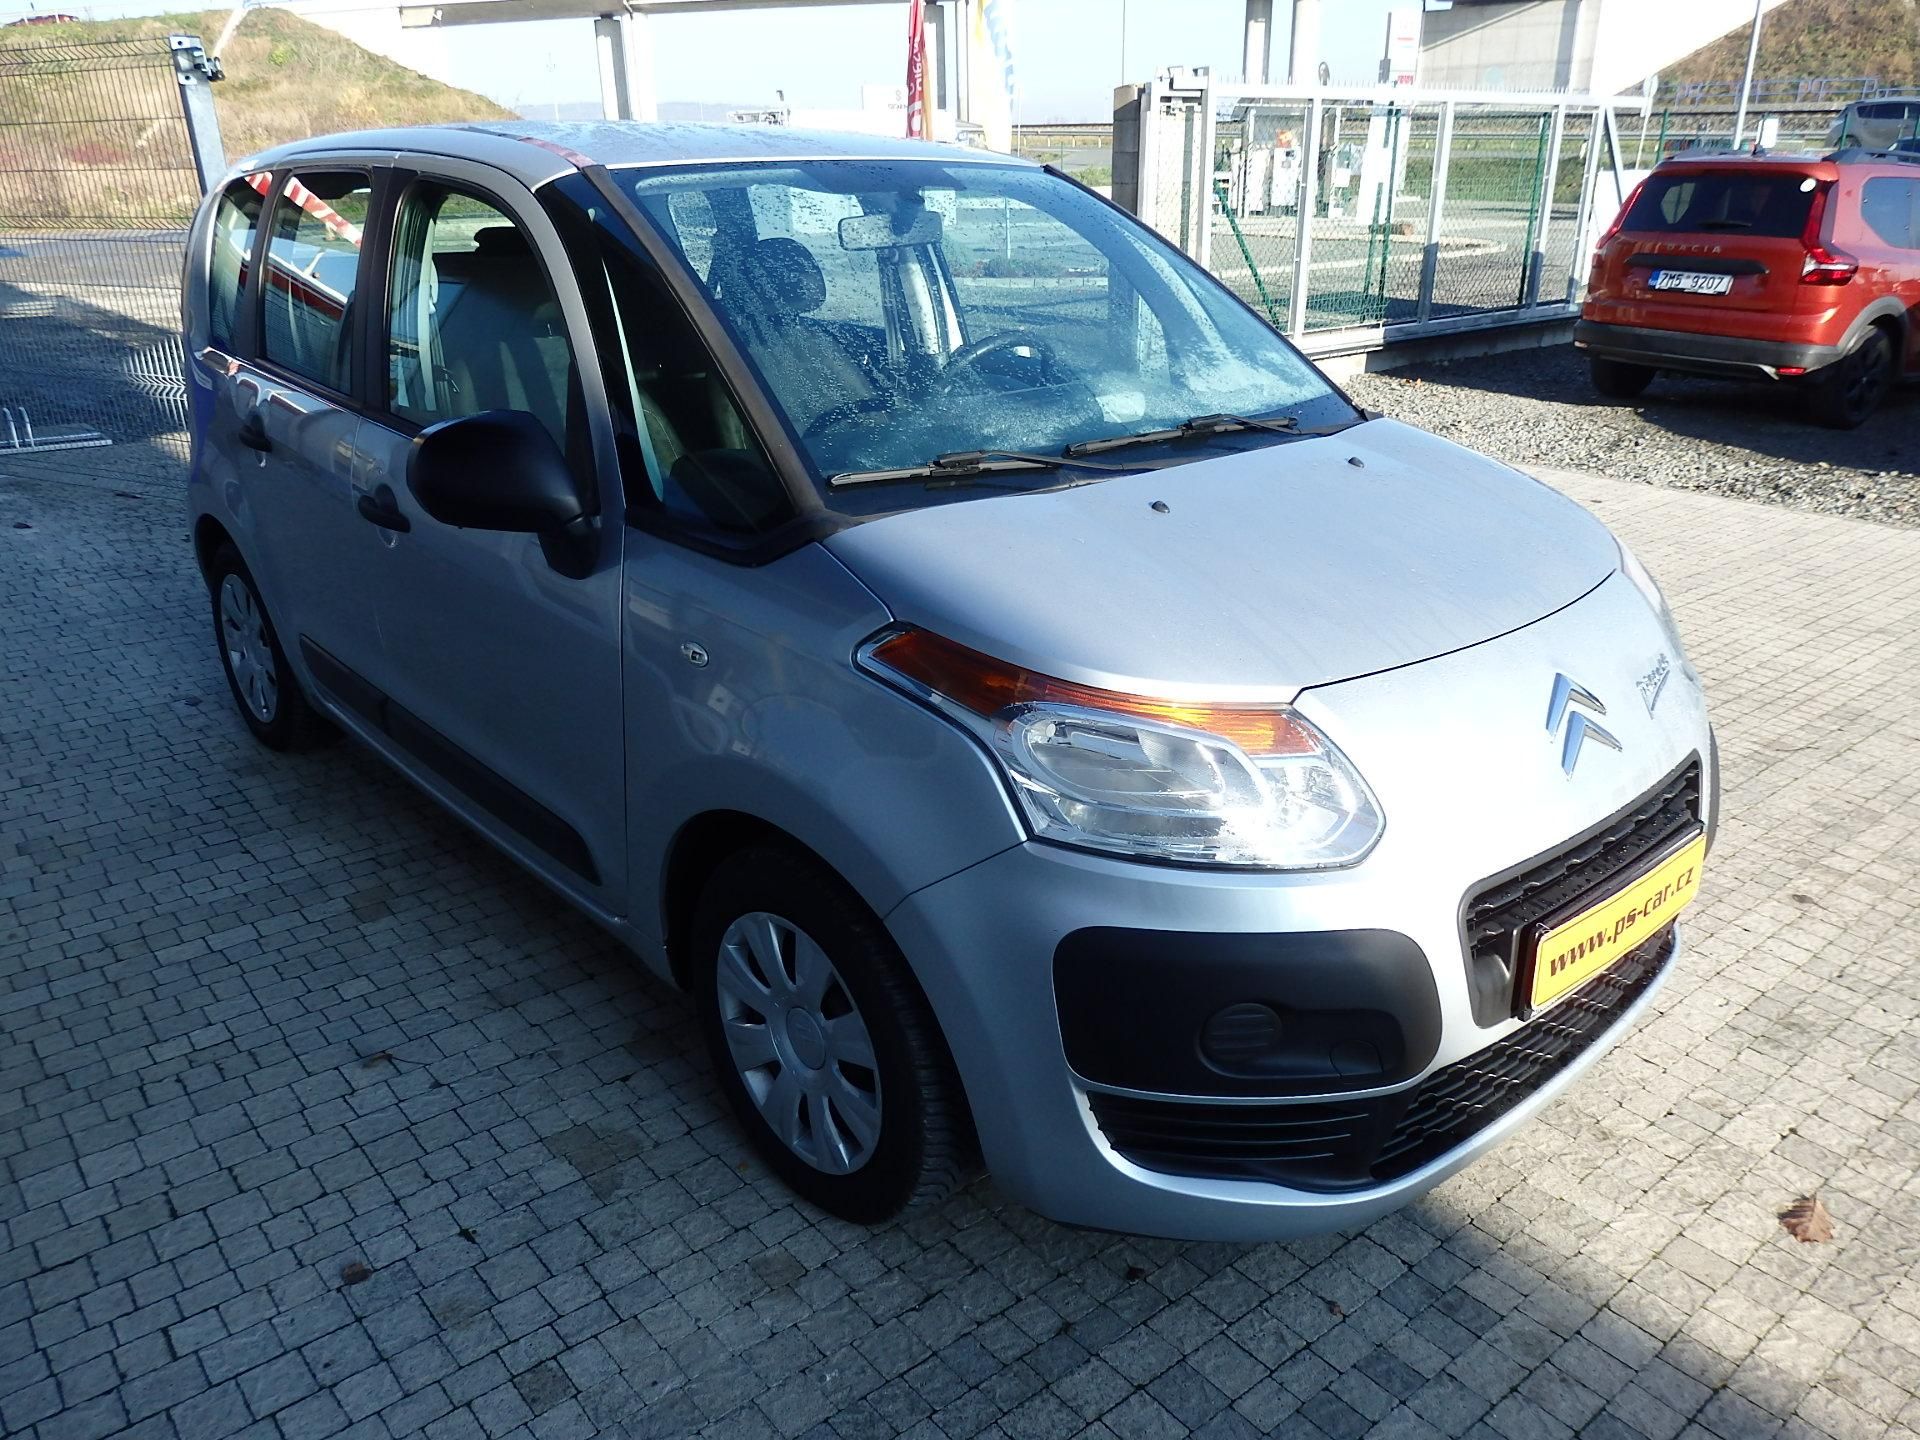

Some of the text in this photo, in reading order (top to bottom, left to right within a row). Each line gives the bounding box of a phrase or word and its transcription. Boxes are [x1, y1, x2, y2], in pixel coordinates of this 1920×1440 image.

[1666, 242, 1721, 254] DACIA
[1658, 272, 1724, 290] 7M5 9207
[1550, 866, 1694, 977] www.ps-car.cz
